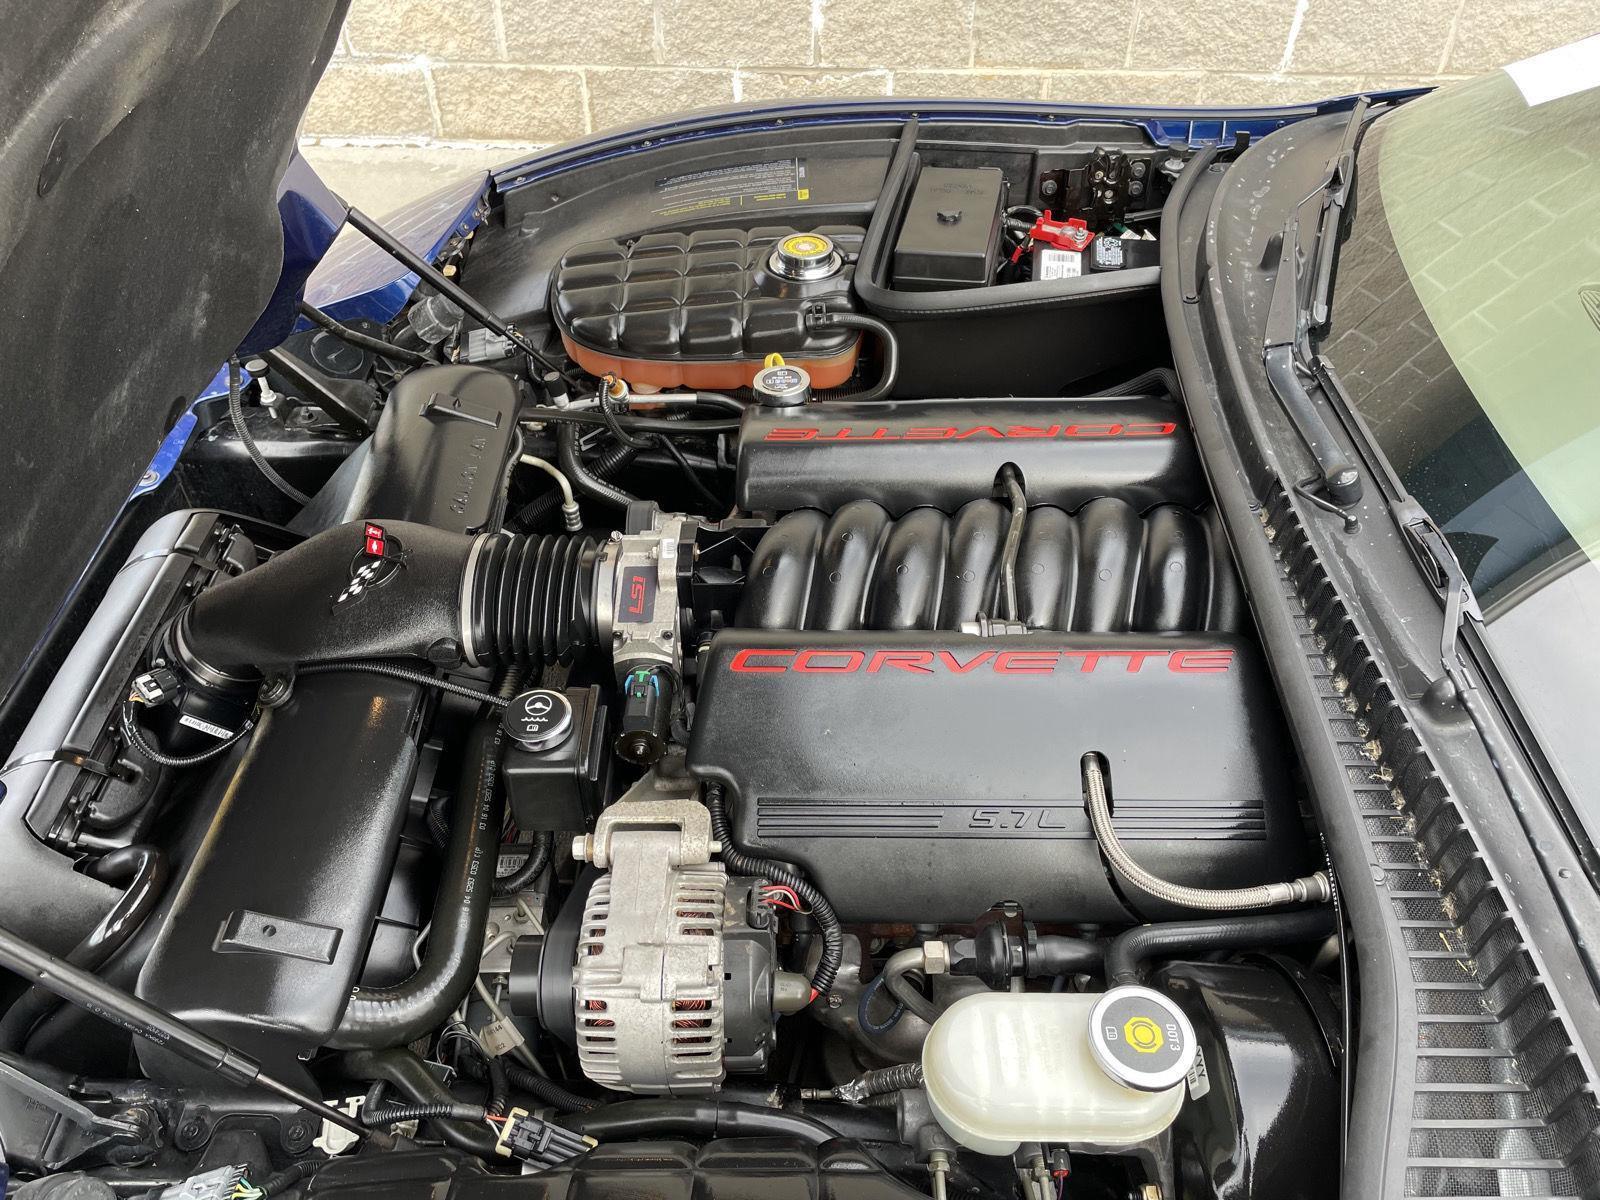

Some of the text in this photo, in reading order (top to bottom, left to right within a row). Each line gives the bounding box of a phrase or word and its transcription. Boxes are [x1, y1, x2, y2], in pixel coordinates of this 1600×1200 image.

[765, 422, 1177, 441] CORVETTE
[628, 575, 645, 614] LS1
[729, 649, 1236, 673] CORVETTE
[967, 809, 1068, 829] 5.7L
[1166, 1023, 1180, 1044] DOT
